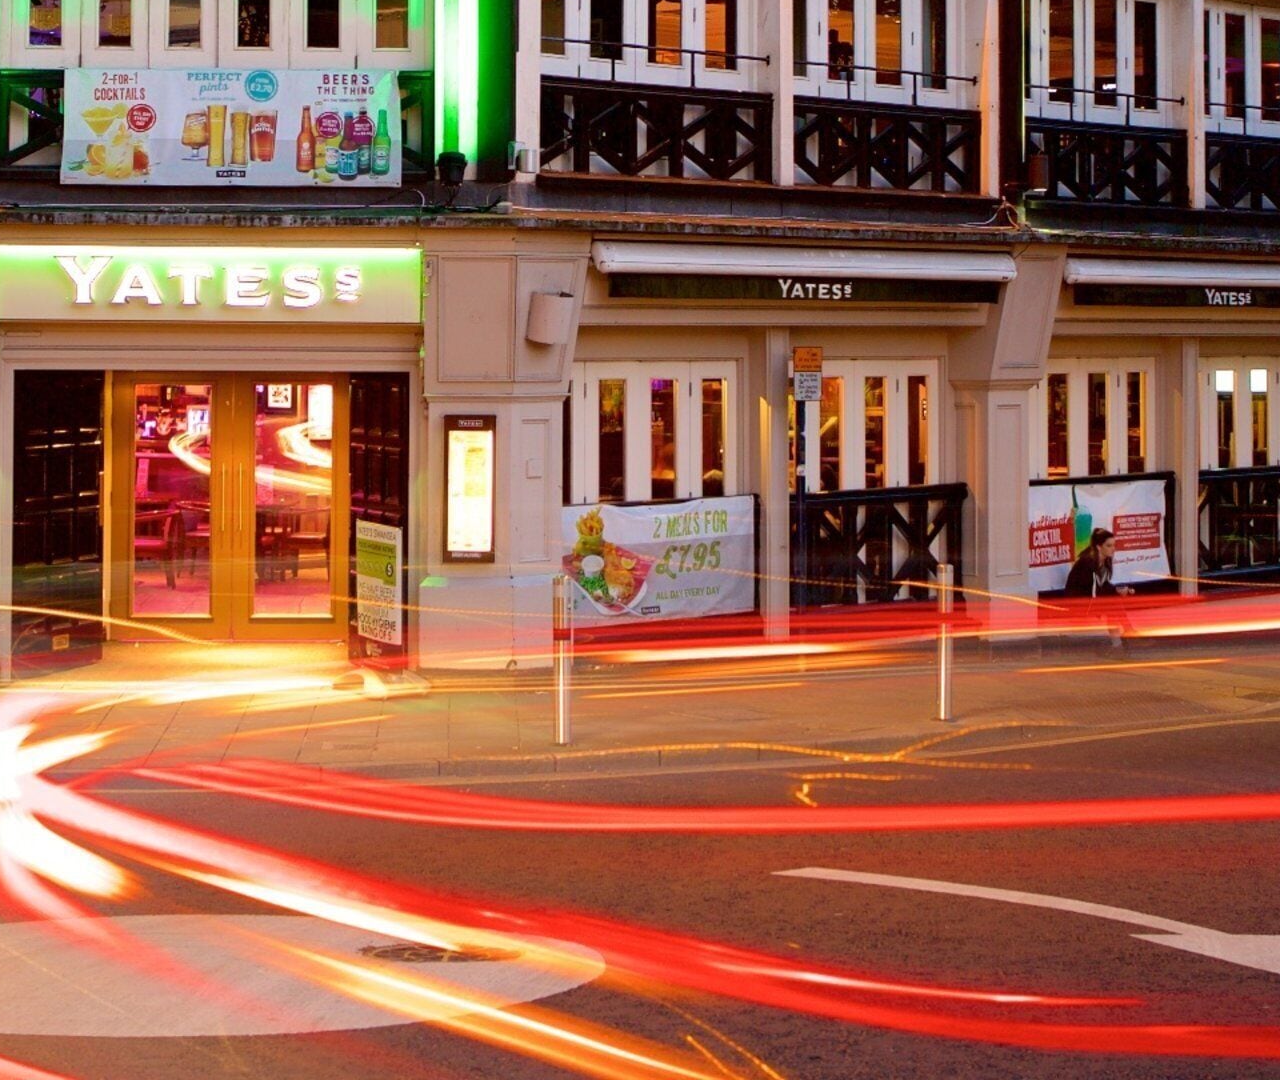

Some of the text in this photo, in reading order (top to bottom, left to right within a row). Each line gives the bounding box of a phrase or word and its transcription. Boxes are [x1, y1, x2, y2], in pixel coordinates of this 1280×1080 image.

[101, 72, 138, 85] 2-FOR-1
[187, 72, 242, 81] PERFECT
[94, 87, 146, 101] COCKTAILS
[200, 82, 229, 95] pints
[317, 86, 375, 96] THE THING
[652, 509, 728, 539] 2 MEALS FOR
[1032, 528, 1062, 547] COCKTAIL
[655, 540, 721, 580] £7.95
[1029, 544, 1071, 566] ASTERCLASS
[655, 591, 669, 600] ALL
[706, 585, 720, 595] DAY
